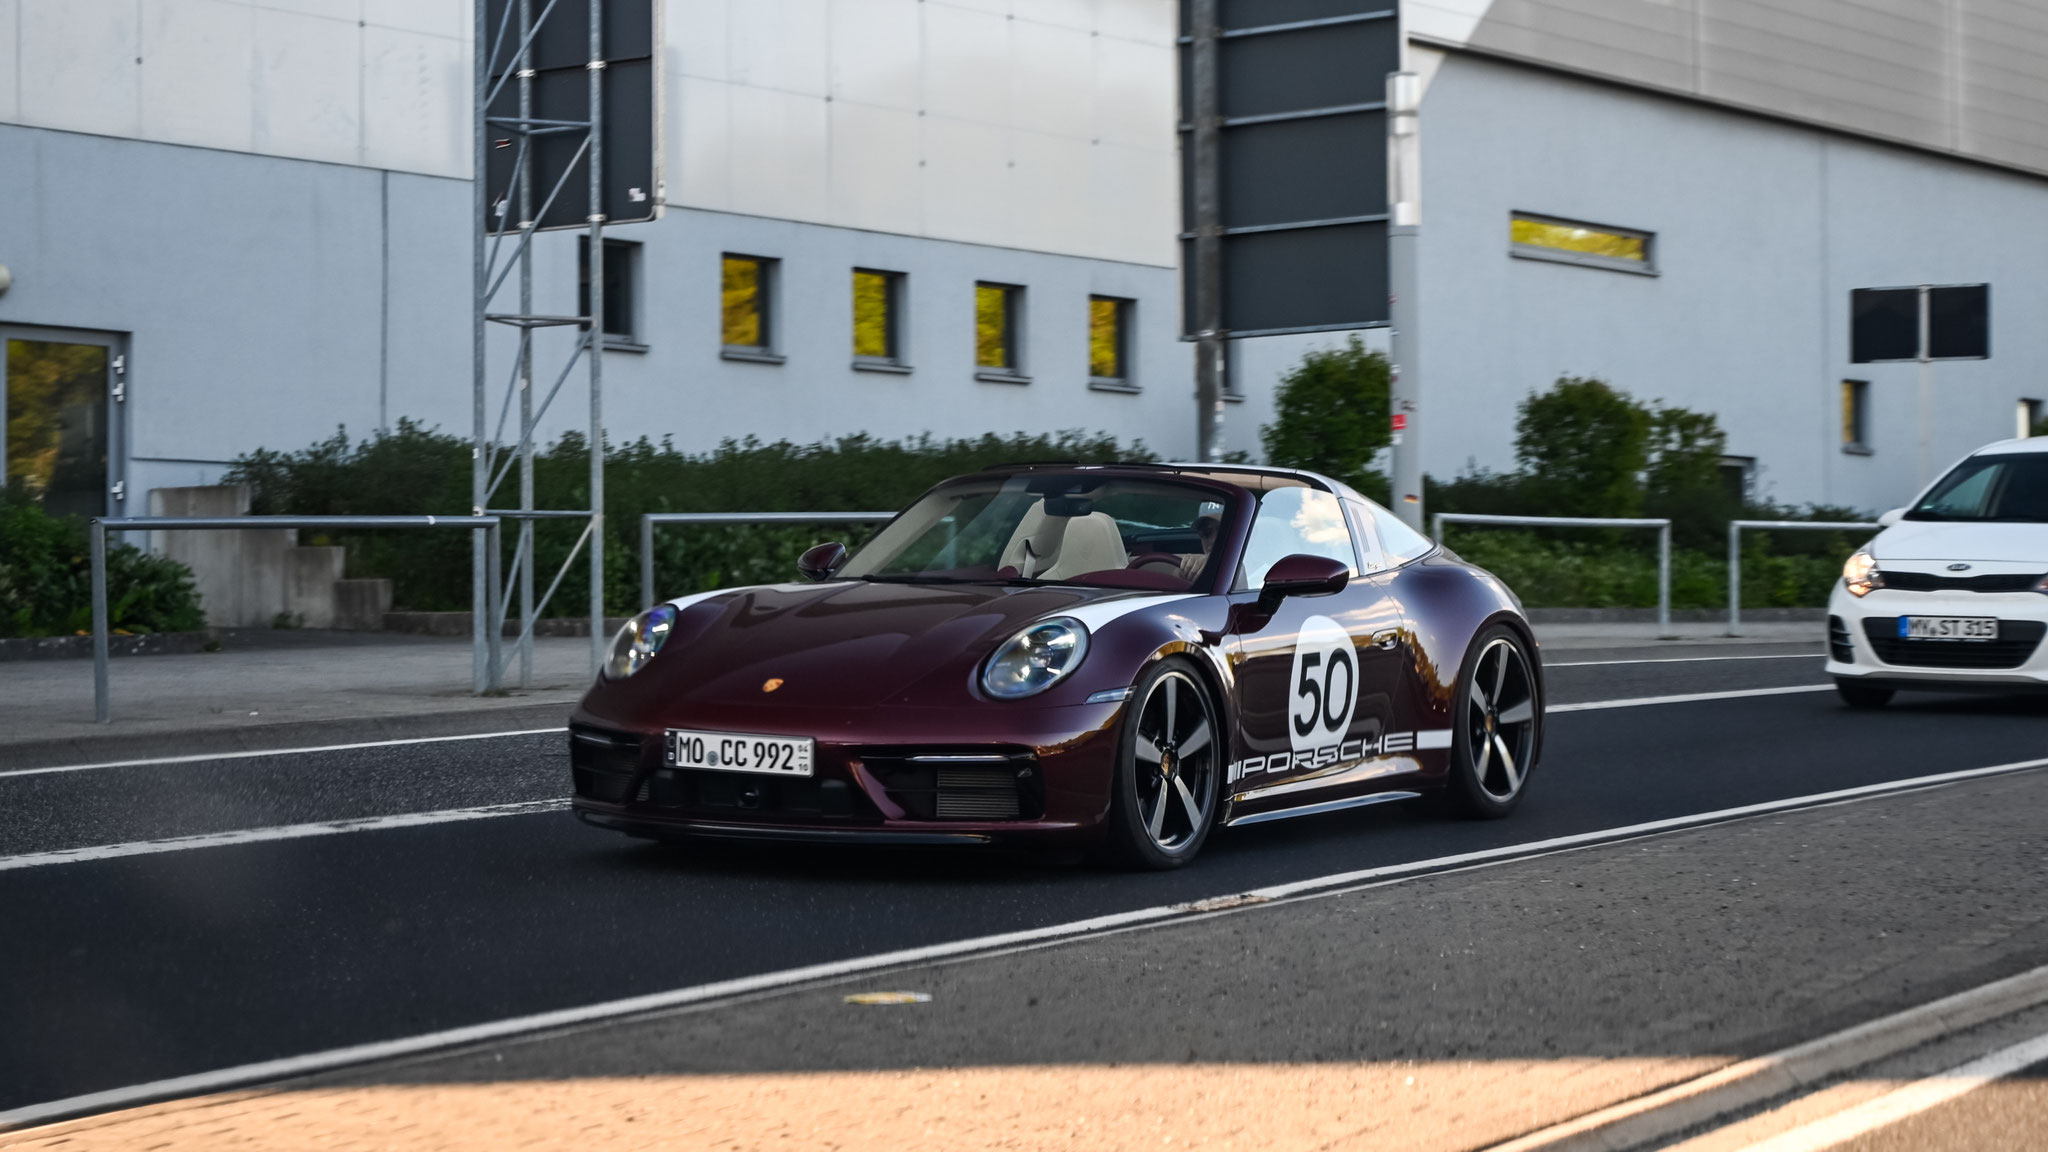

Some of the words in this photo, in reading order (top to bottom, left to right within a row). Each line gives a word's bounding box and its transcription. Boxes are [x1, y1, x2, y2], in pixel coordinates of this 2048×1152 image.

[1939, 620, 1960, 635] ST
[1964, 620, 1995, 636] 315
[1294, 648, 1353, 737] 50
[678, 736, 704, 763] MO
[721, 739, 747, 766] CC
[753, 742, 794, 770] 992
[1242, 731, 1413, 778] PORSCHE
